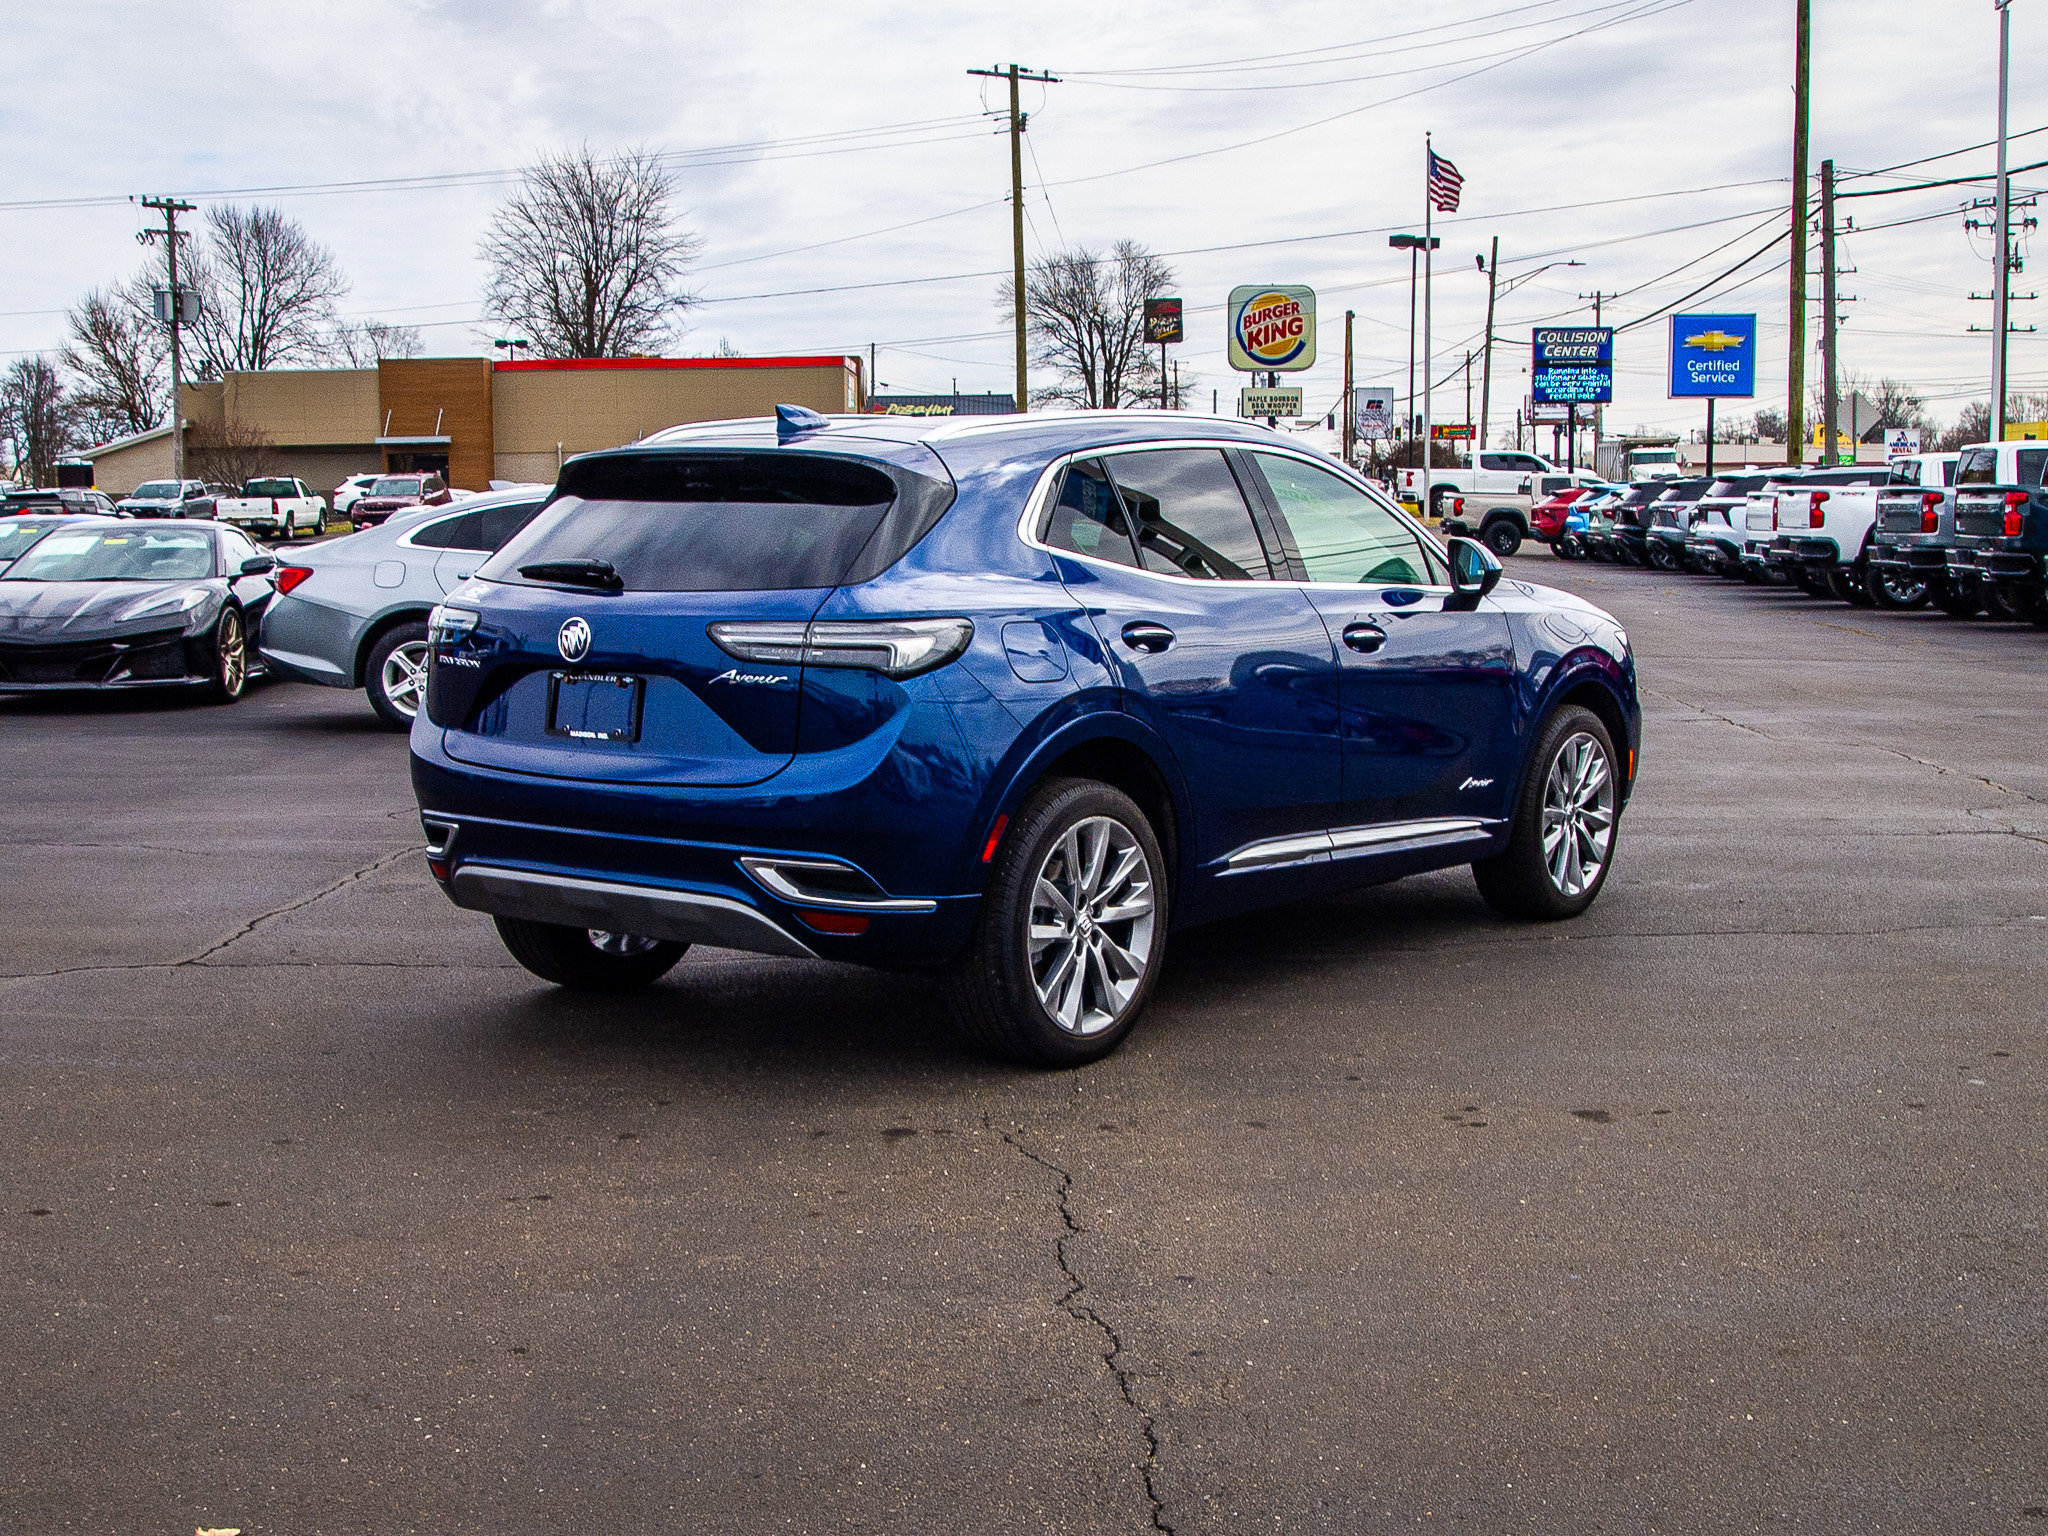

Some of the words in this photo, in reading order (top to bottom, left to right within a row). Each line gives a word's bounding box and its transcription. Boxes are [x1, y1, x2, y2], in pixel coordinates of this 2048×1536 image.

[1243, 301, 1300, 330] BURGER
[1247, 316, 1303, 351] KING
[1537, 331, 1608, 343] COLLISION
[1544, 345, 1598, 357] CENTER
[1687, 360, 1740, 371] Certified
[1691, 371, 1735, 383] Service
[886, 403, 926, 415] Pizza
[925, 403, 955, 417] Hut
[708, 669, 788, 684] Avenir
